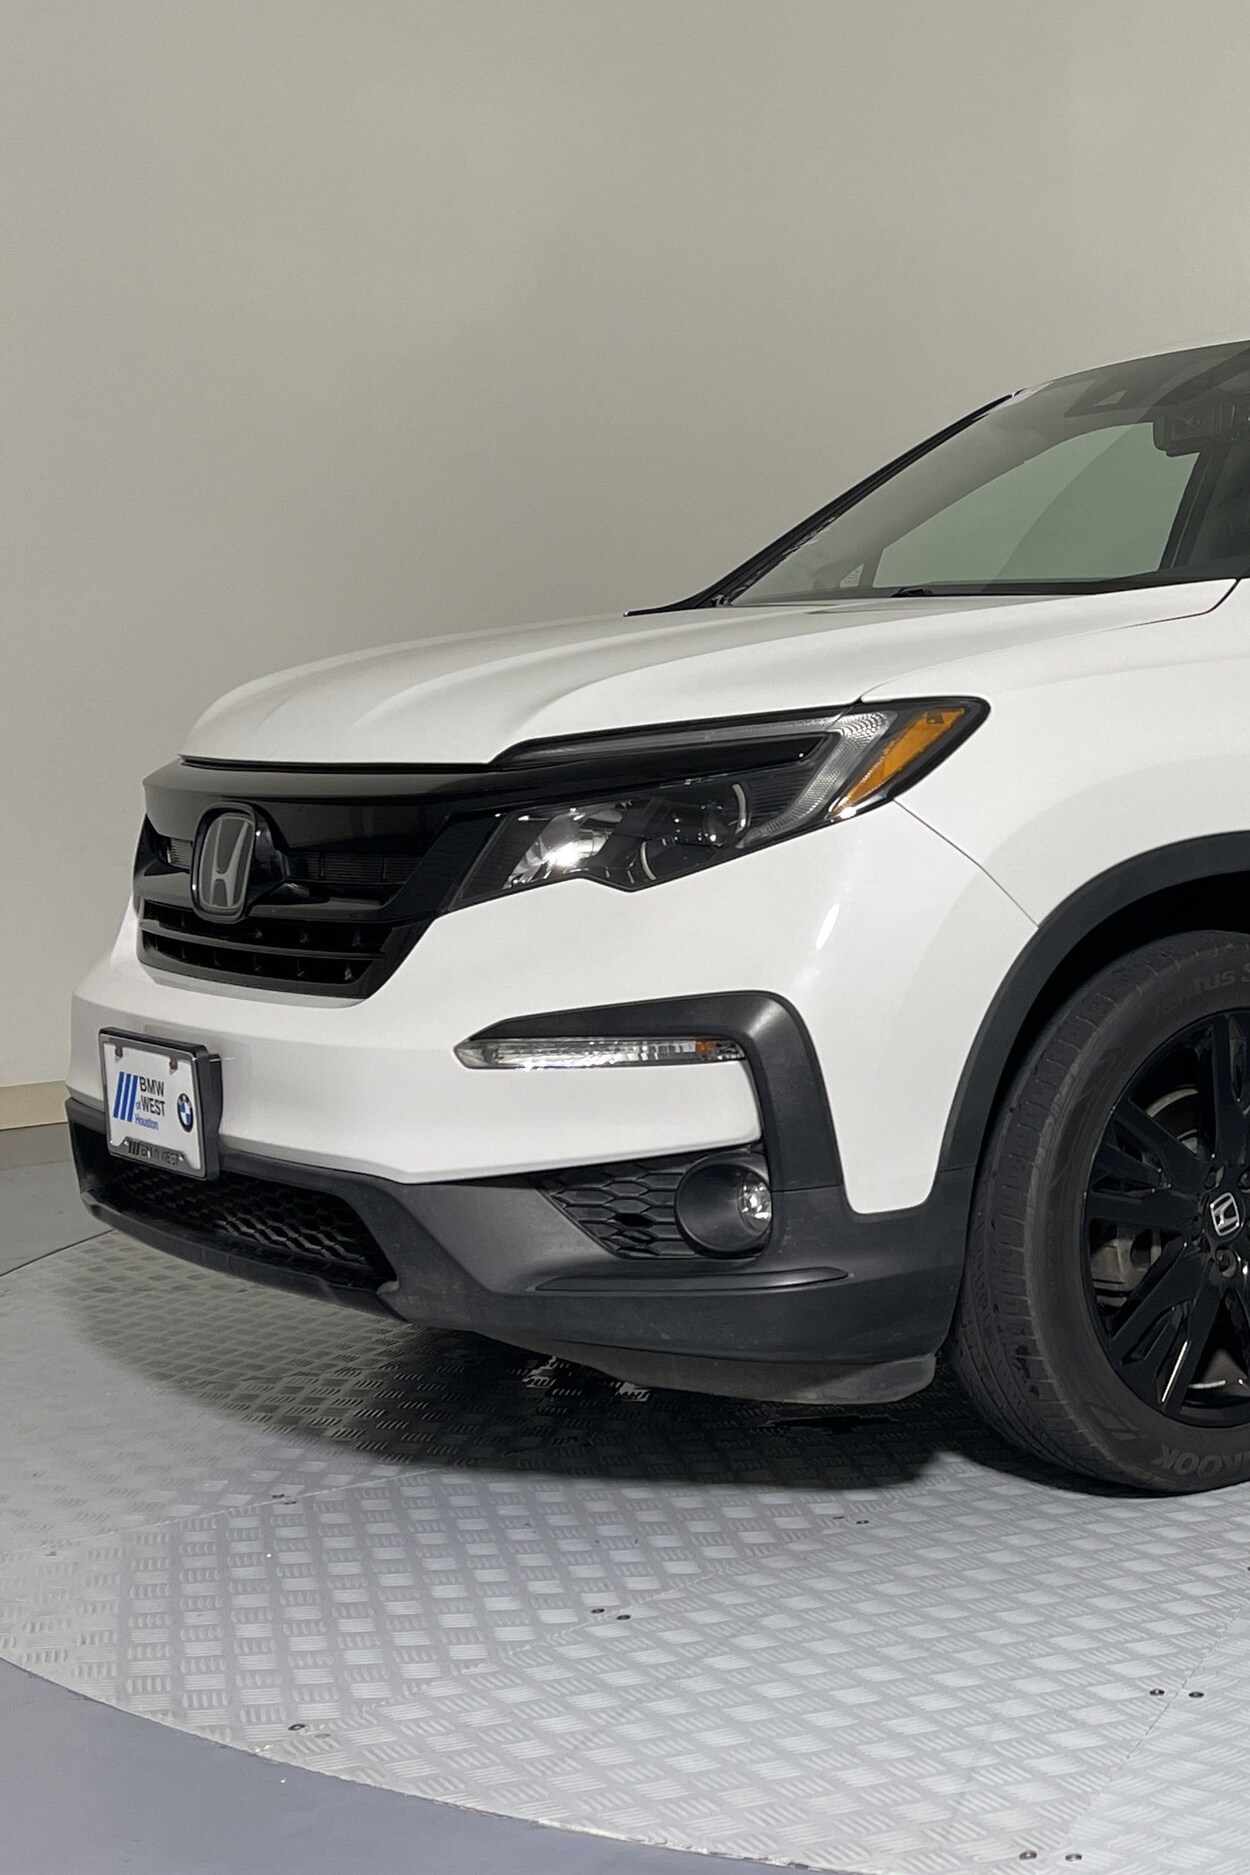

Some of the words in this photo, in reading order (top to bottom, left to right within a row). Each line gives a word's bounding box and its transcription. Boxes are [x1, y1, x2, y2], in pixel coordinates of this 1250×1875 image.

[139, 1076, 164, 1097] BMW
[141, 1096, 165, 1117] WEST
[135, 1114, 160, 1130] Houston
